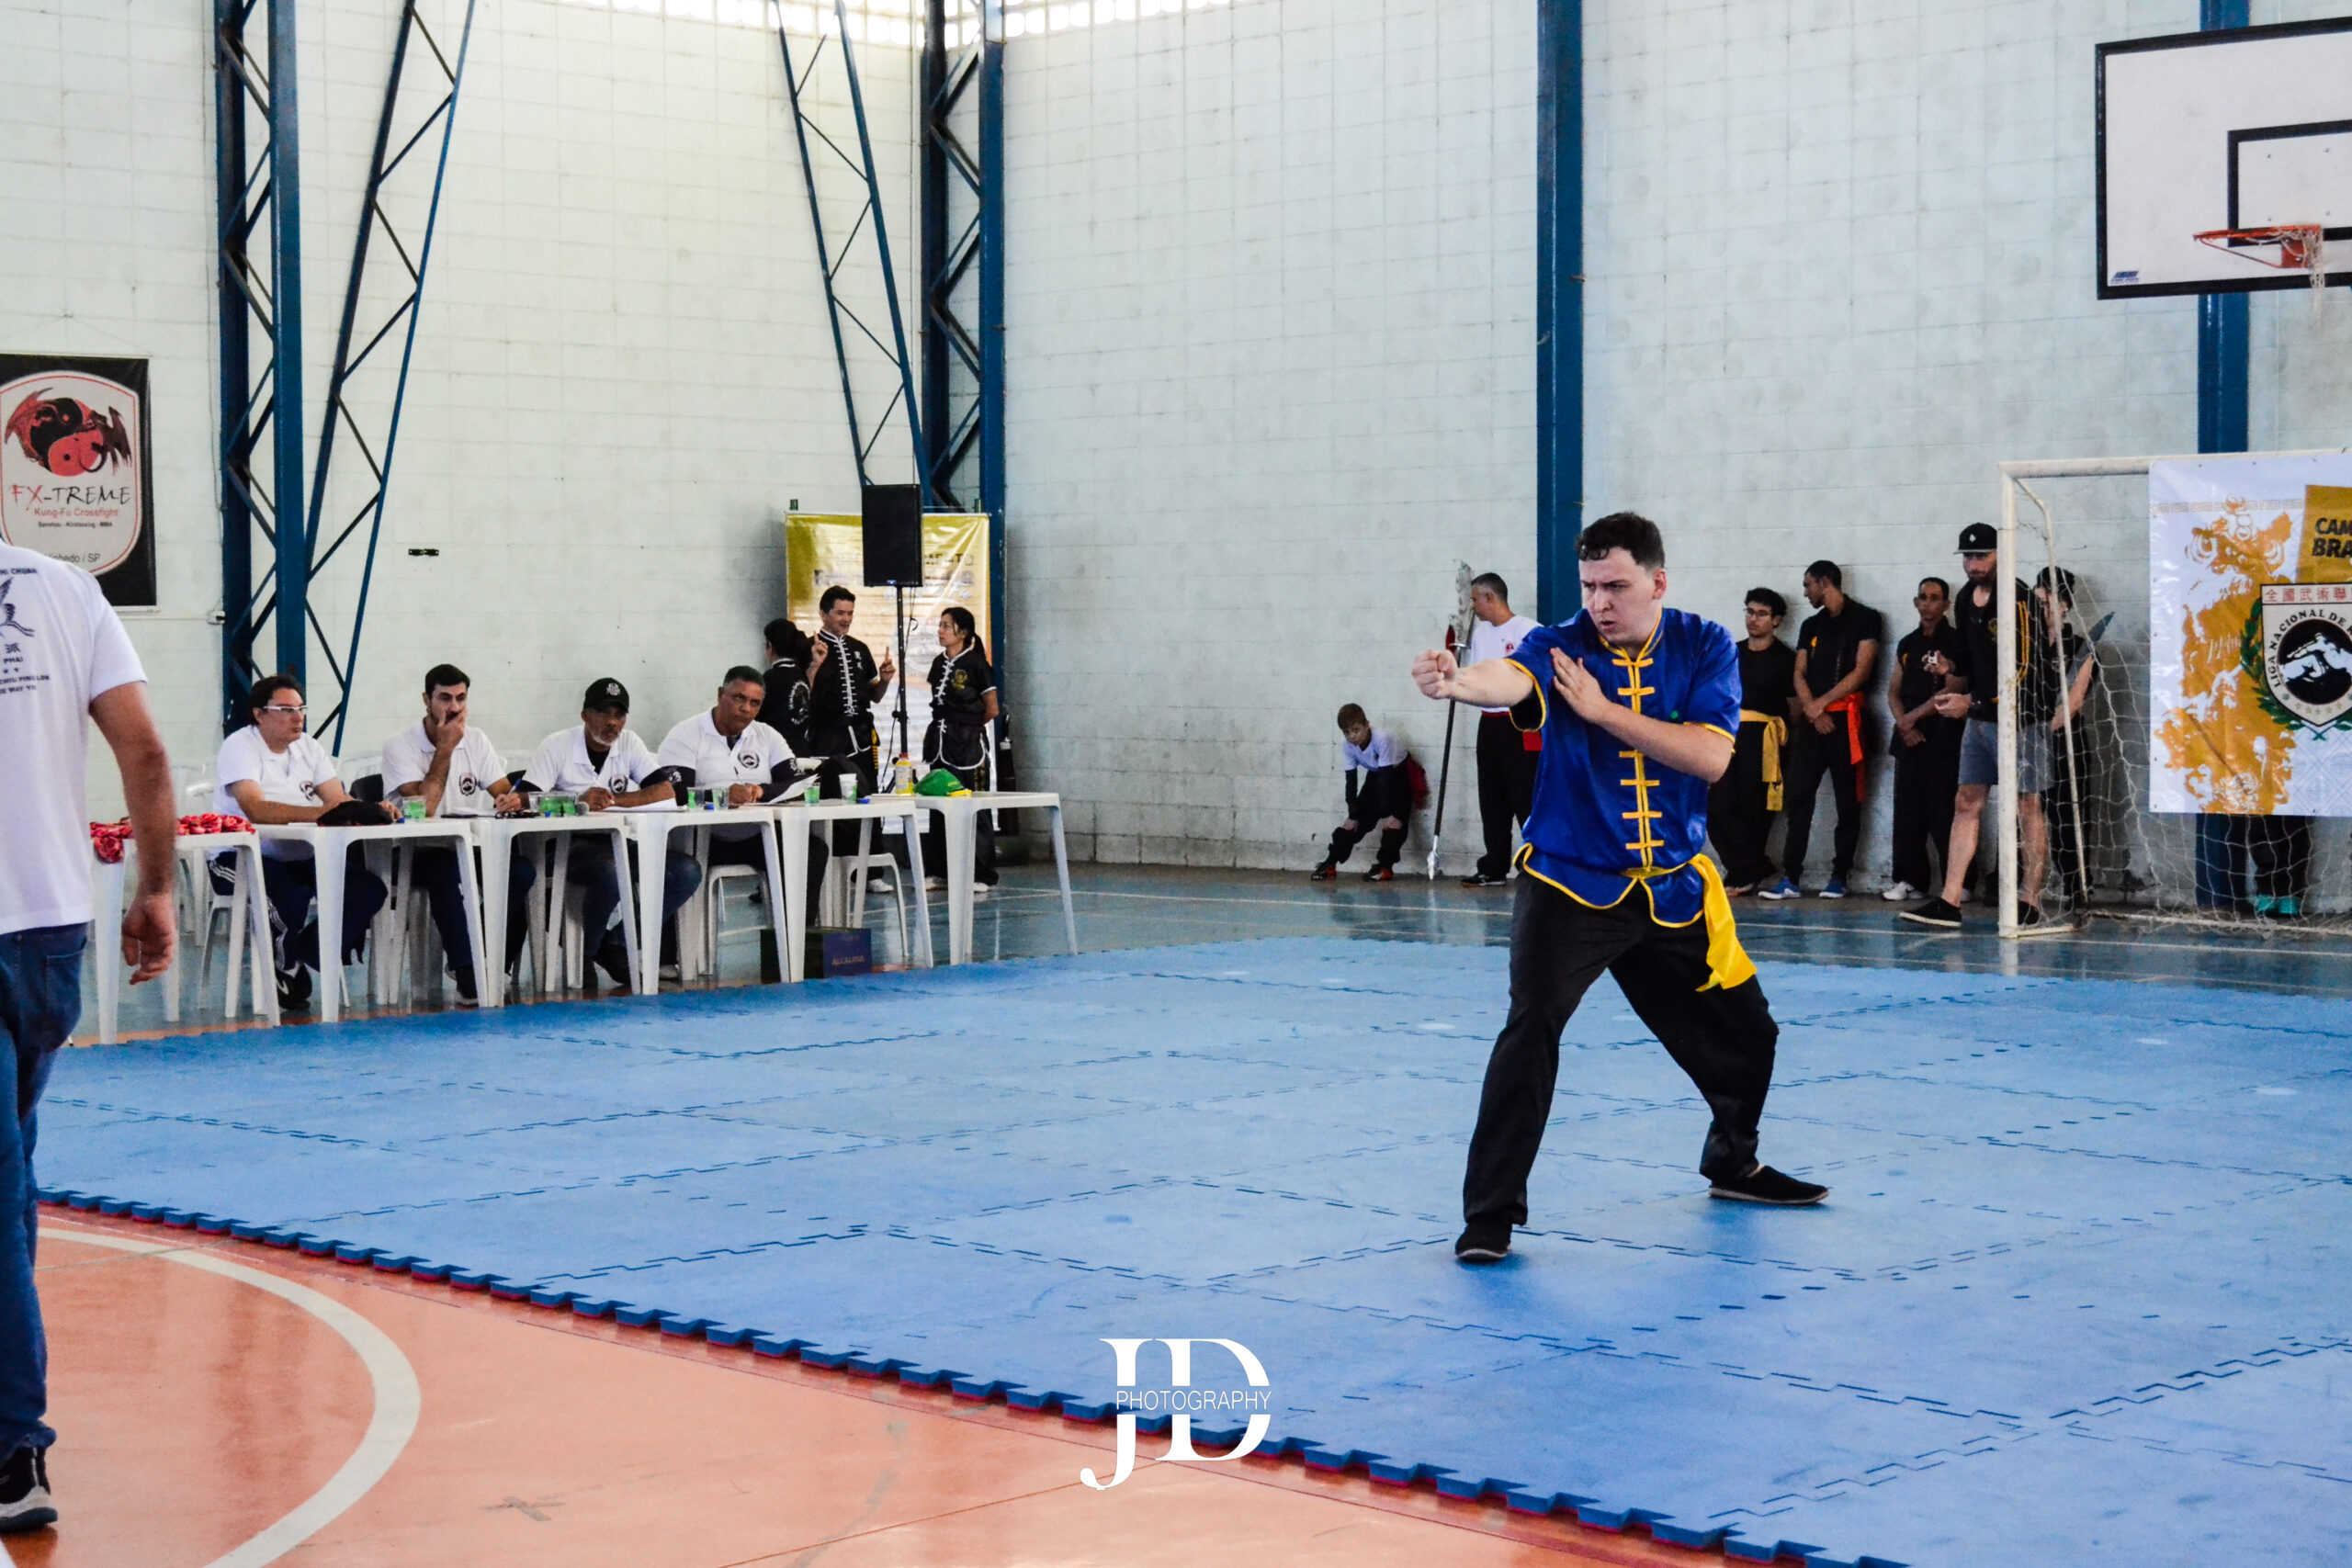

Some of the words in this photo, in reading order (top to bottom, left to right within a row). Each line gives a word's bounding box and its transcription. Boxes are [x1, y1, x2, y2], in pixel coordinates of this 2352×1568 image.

[9, 484, 131, 507] FX-TREME
[34, 507, 72, 519] Kung-Fu
[74, 507, 119, 519] Crossfight
[87, 553, 100, 563] SP
[2329, 612, 2346, 626] DE
[2269, 609, 2325, 649] NACIONAL
[2268, 656, 2281, 687] LIGA
